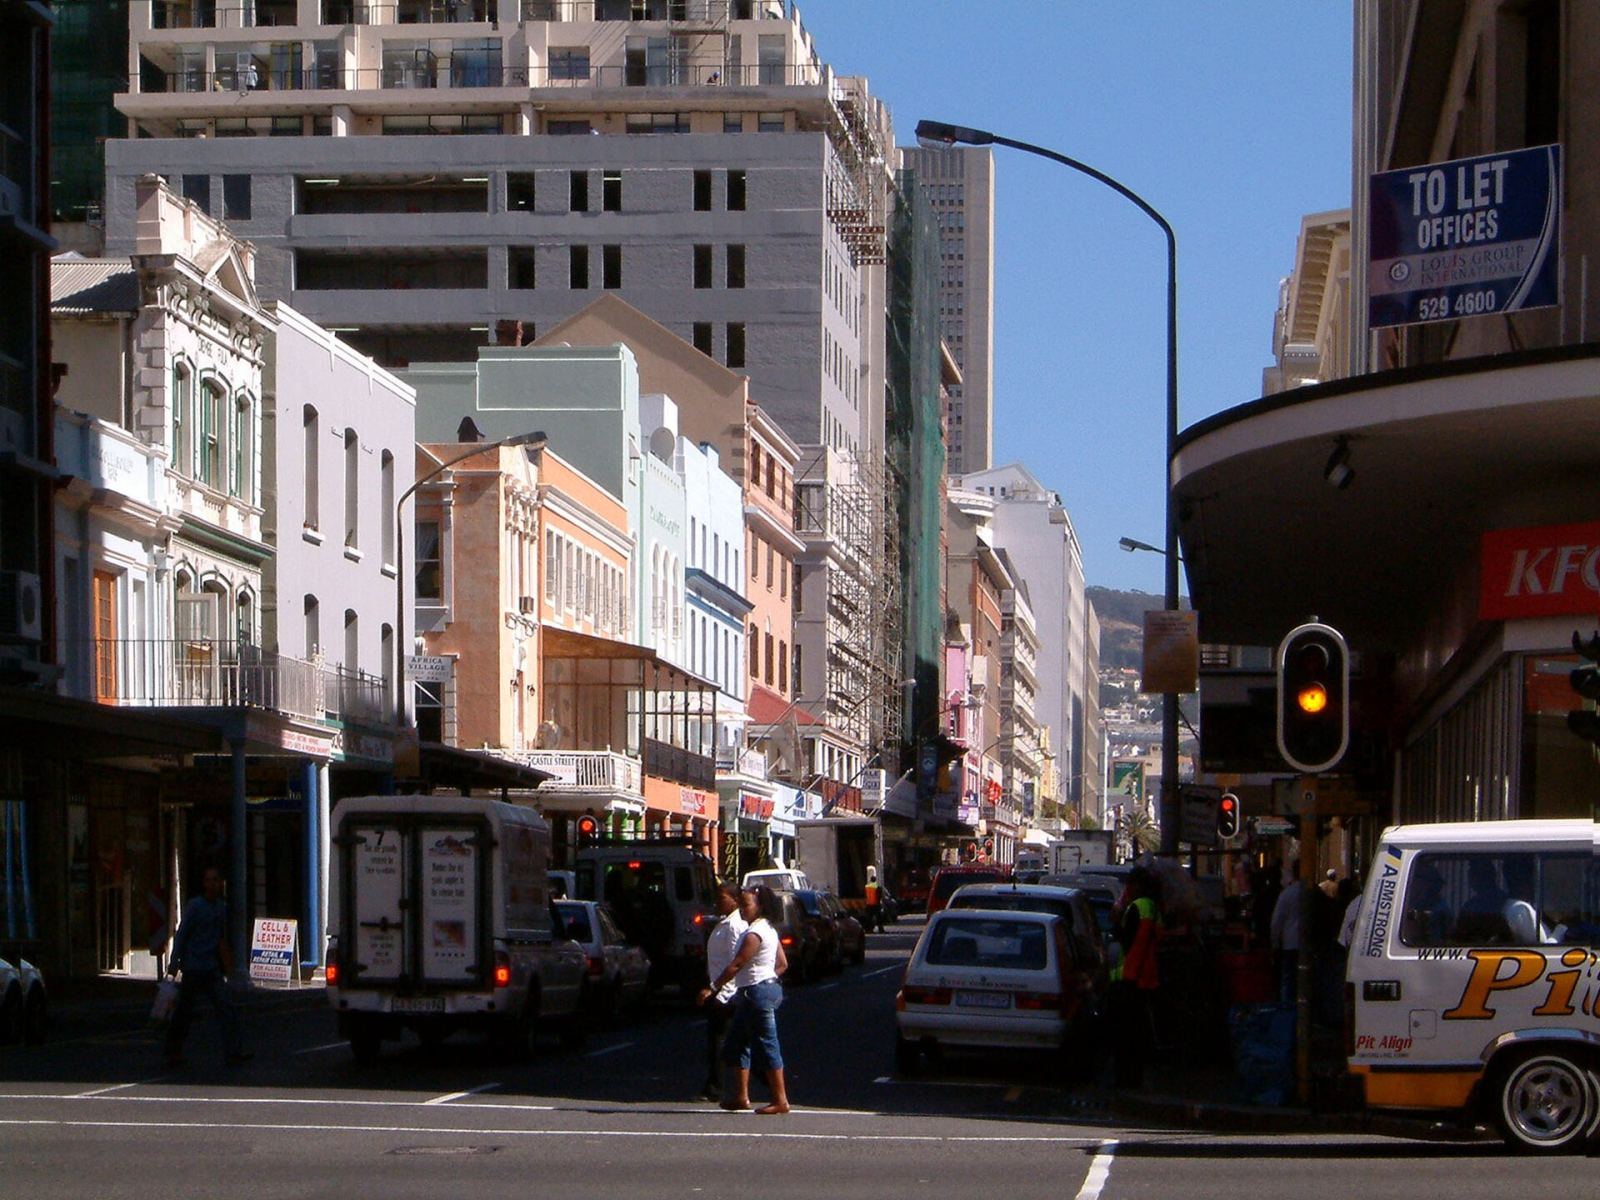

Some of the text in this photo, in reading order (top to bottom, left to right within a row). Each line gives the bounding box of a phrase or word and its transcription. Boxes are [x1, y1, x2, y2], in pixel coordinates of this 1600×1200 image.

[1409, 160, 1508, 216] TO LET
[1418, 209, 1498, 249] OFFICES
[1420, 245, 1526, 272] LOUIS GROUP
[1420, 262, 1524, 284] INTERNATIONAL
[1419, 290, 1495, 319] 529 4600
[531, 756, 575, 766] CASTLE STREET
[1370, 864, 1398, 958] ARMSTRONG
[256, 933, 292, 944] LEATHER
[261, 921, 281, 932] CELL
[1442, 949, 1600, 1020] Pi
[1357, 1035, 1413, 1052] Pit Align
